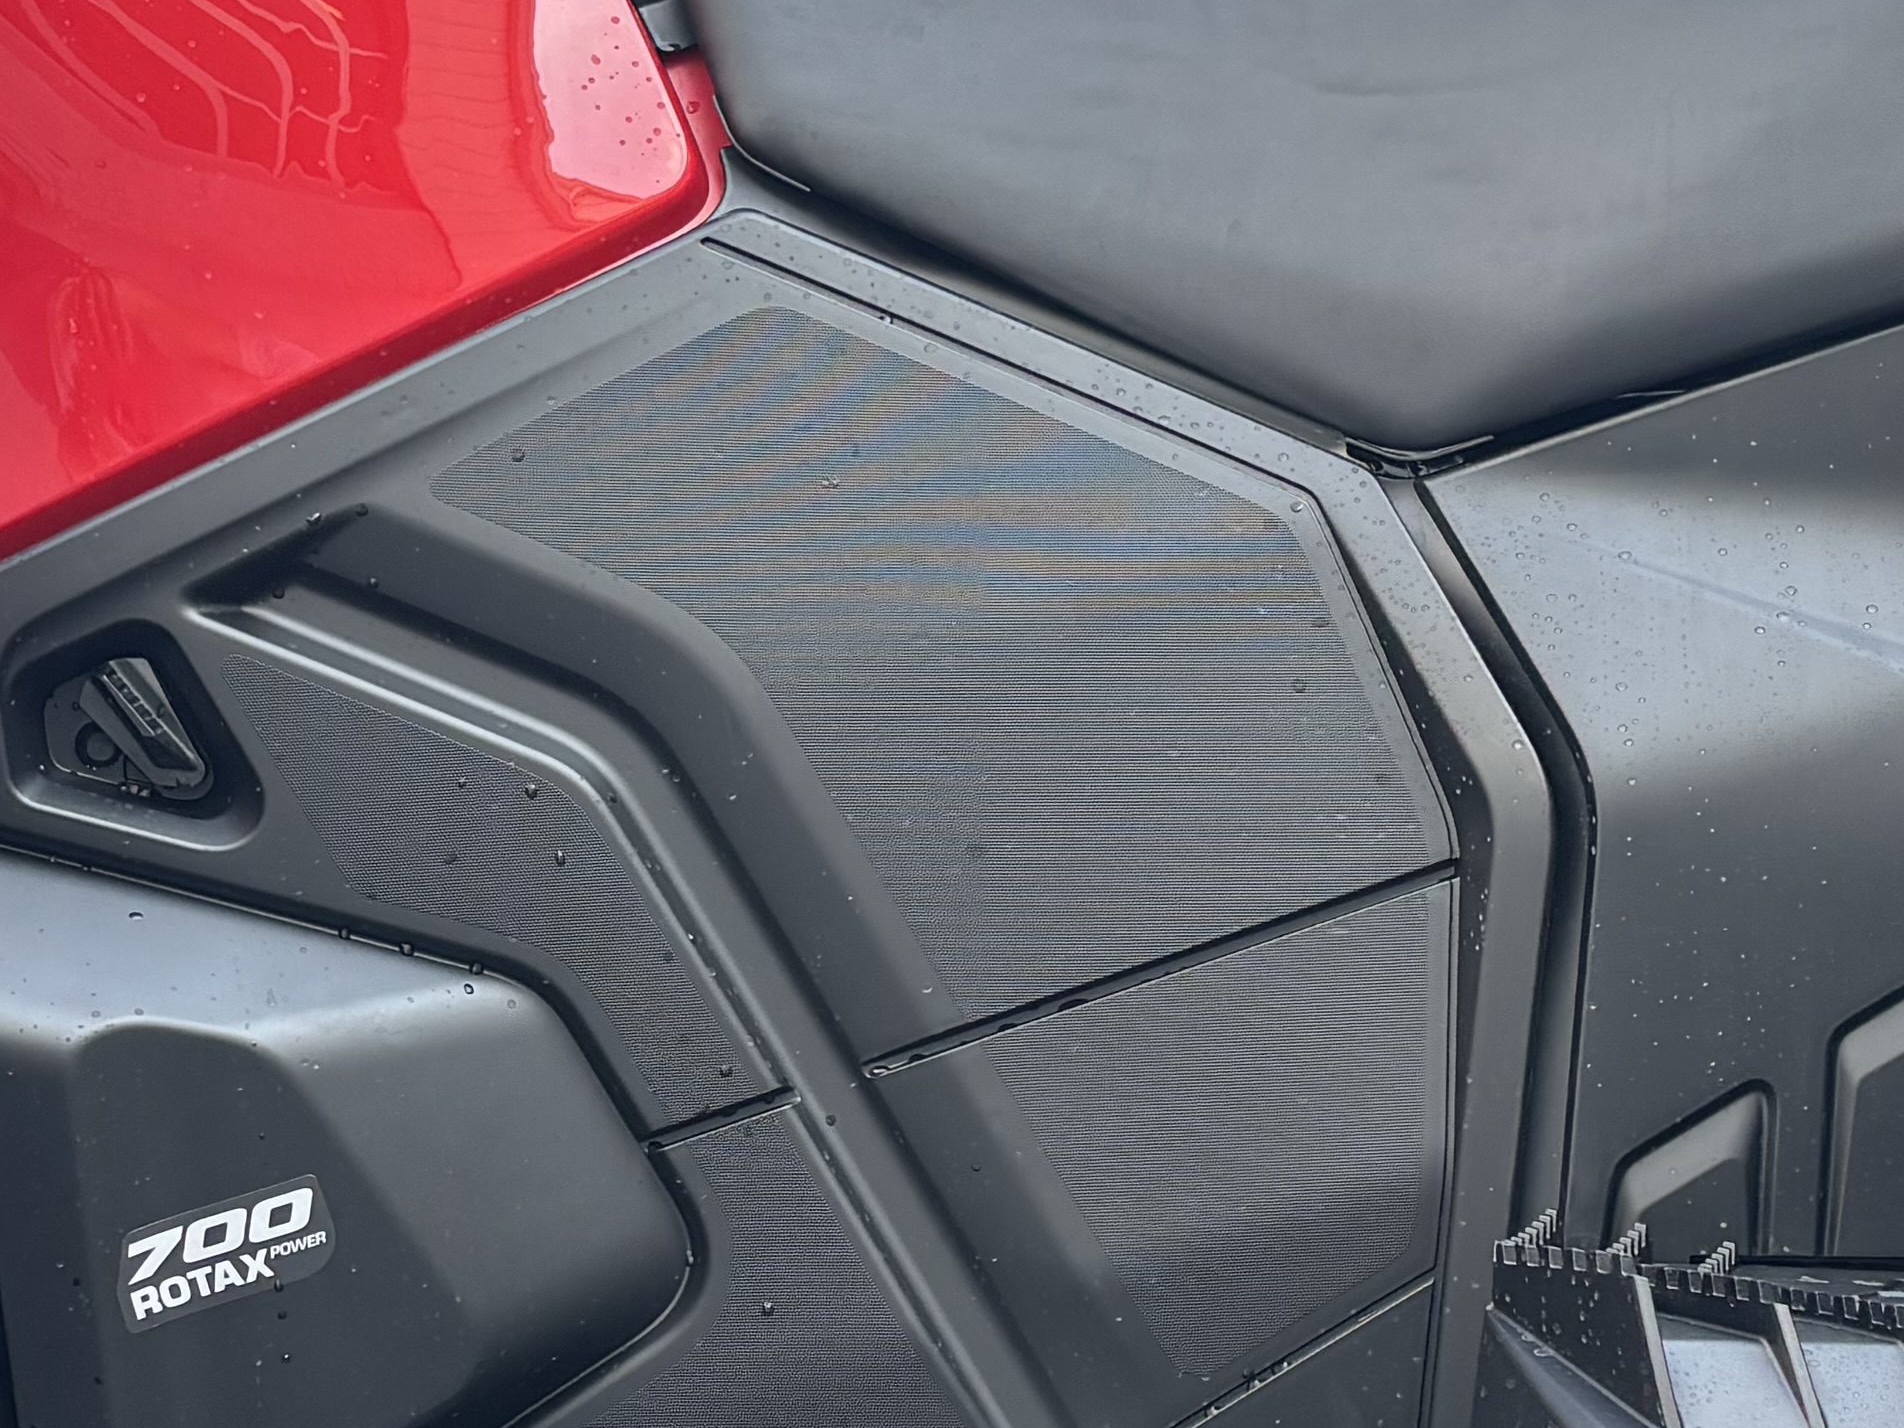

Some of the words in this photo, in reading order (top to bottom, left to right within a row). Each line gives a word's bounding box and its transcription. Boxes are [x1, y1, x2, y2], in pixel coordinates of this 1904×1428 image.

[127, 1187, 314, 1286] 700
[129, 1247, 275, 1321] ROTAX
[269, 1230, 327, 1259] POWER
